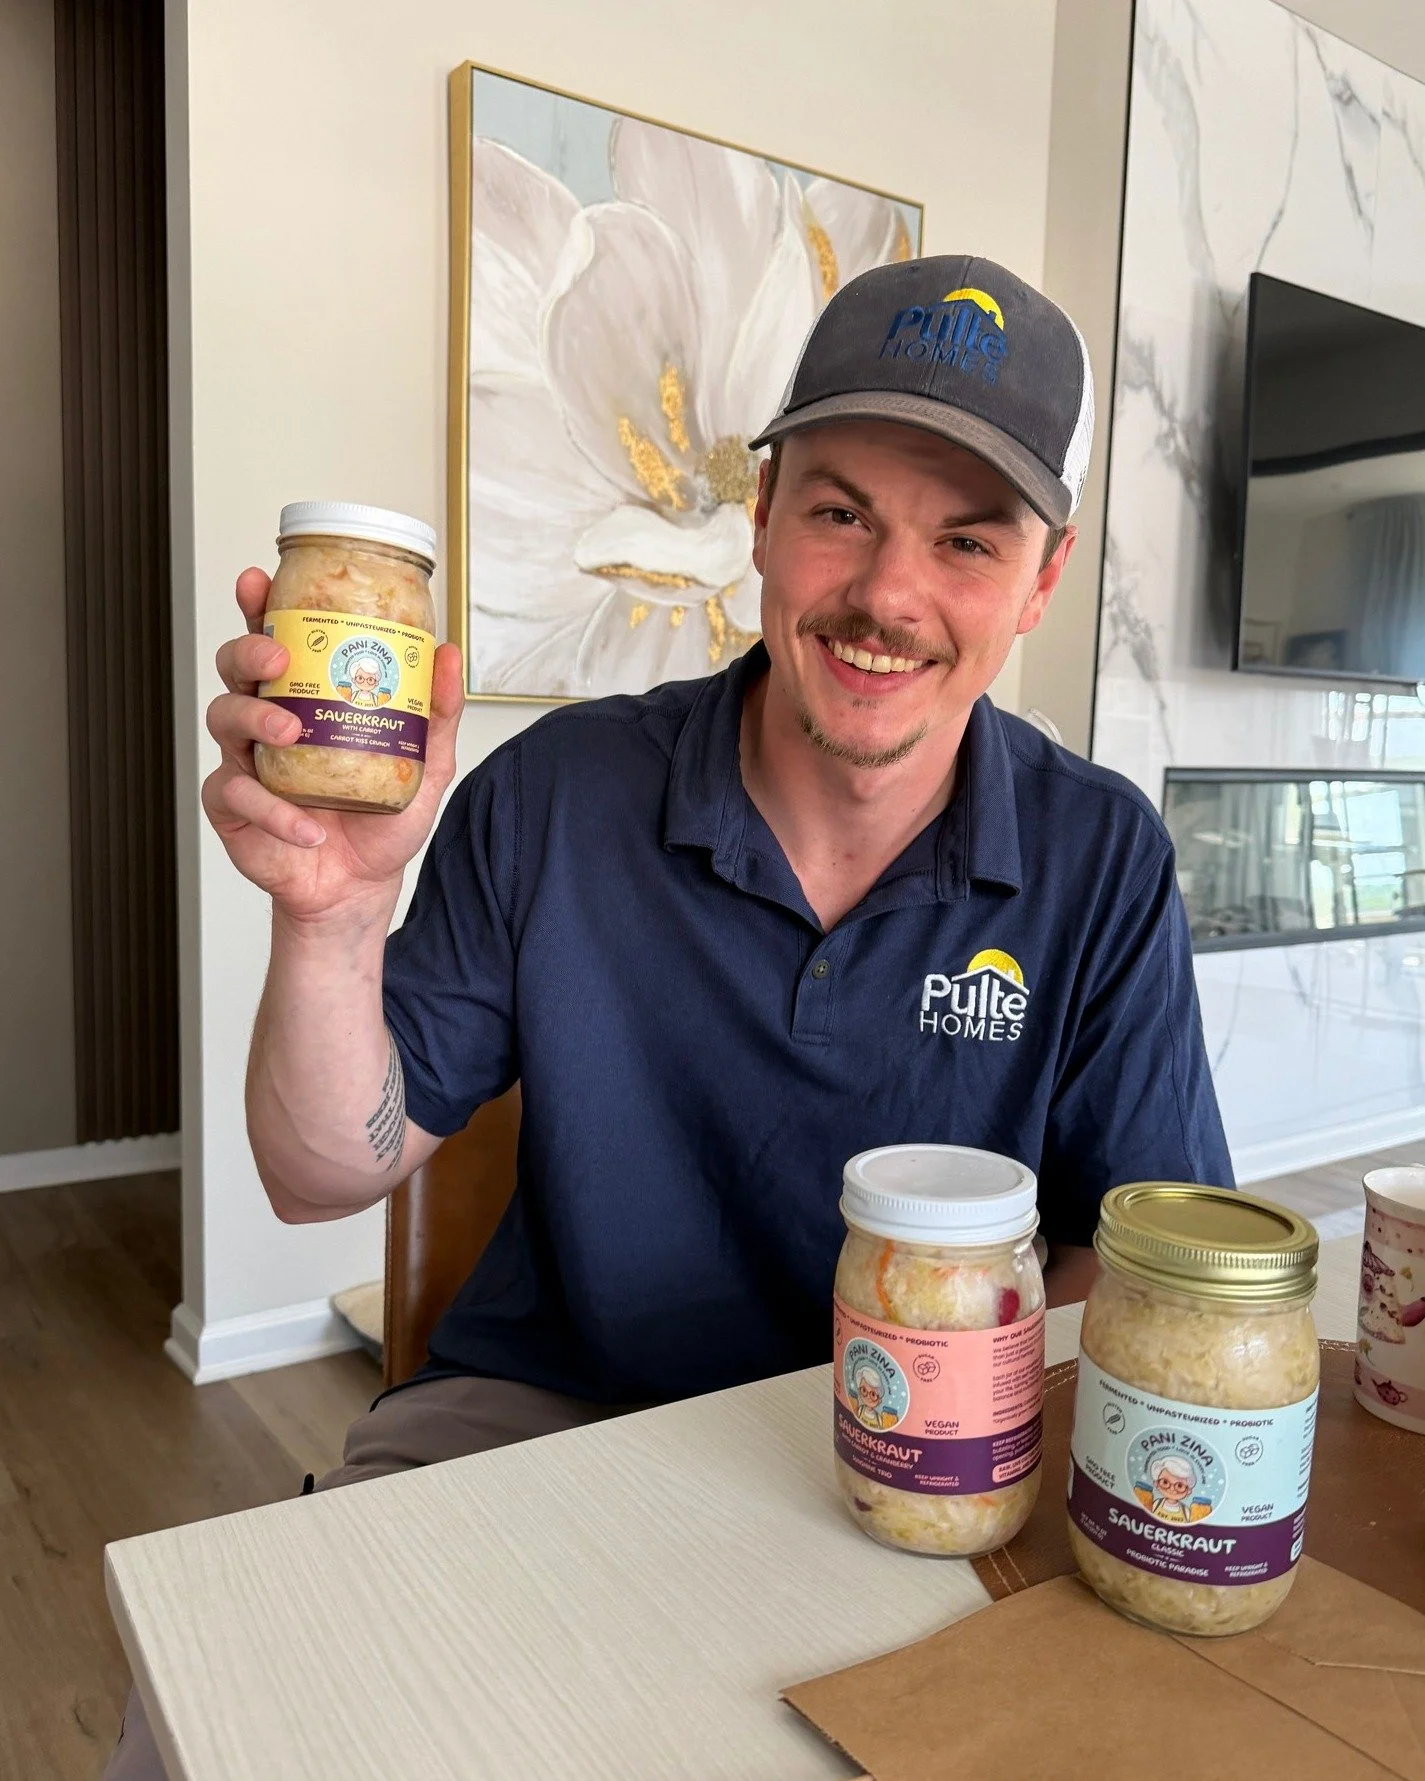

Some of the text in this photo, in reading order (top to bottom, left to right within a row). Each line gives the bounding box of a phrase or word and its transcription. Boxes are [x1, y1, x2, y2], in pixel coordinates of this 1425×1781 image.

[886, 304, 1009, 361] Pulte
[879, 339, 997, 385] HOMES
[302, 616, 339, 625] FERMENTED
[345, 621, 397, 635] UNPASTEURIZED
[341, 640, 368, 657] PANI
[370, 641, 393, 665] ZINA
[289, 687, 320, 695] PRODUCT
[407, 698, 424, 707] VEGAN
[314, 708, 406, 732] SAUERKRAUT
[359, 726, 382, 735] CARROT
[330, 734, 355, 743] CARROT
[355, 737, 368, 745] KISS
[369, 739, 391, 748] CRUNCH
[921, 973, 1027, 1021] Pulte
[920, 1010, 1024, 1041] HOMES
[905, 1336, 949, 1347] PROBIOTIC
[849, 1343, 868, 1361] PANI
[871, 1347, 896, 1379] ZINA
[1099, 1379, 1139, 1405] FERMENTED
[1146, 1403, 1220, 1426] UNPASTEURIZED
[1230, 1418, 1275, 1427] PROBIOTIC
[925, 1420, 960, 1429] VEGAN
[925, 1428, 959, 1436] PRODUCT
[838, 1413, 923, 1463] SAUERKRAUT
[1141, 1432, 1176, 1452] PANI
[1180, 1435, 1214, 1467] ZINA
[875, 1454, 914, 1469] CRANBERRY
[877, 1468, 893, 1479] TRIO
[1241, 1503, 1275, 1514] VEGAN
[1241, 1512, 1273, 1521] PRODUCT
[1108, 1507, 1237, 1555] SAUERKRAUT
[1150, 1543, 1185, 1557] CLASSIC
[1126, 1548, 1168, 1569] PROBIOTIC
[1168, 1563, 1210, 1577] PARADISE
